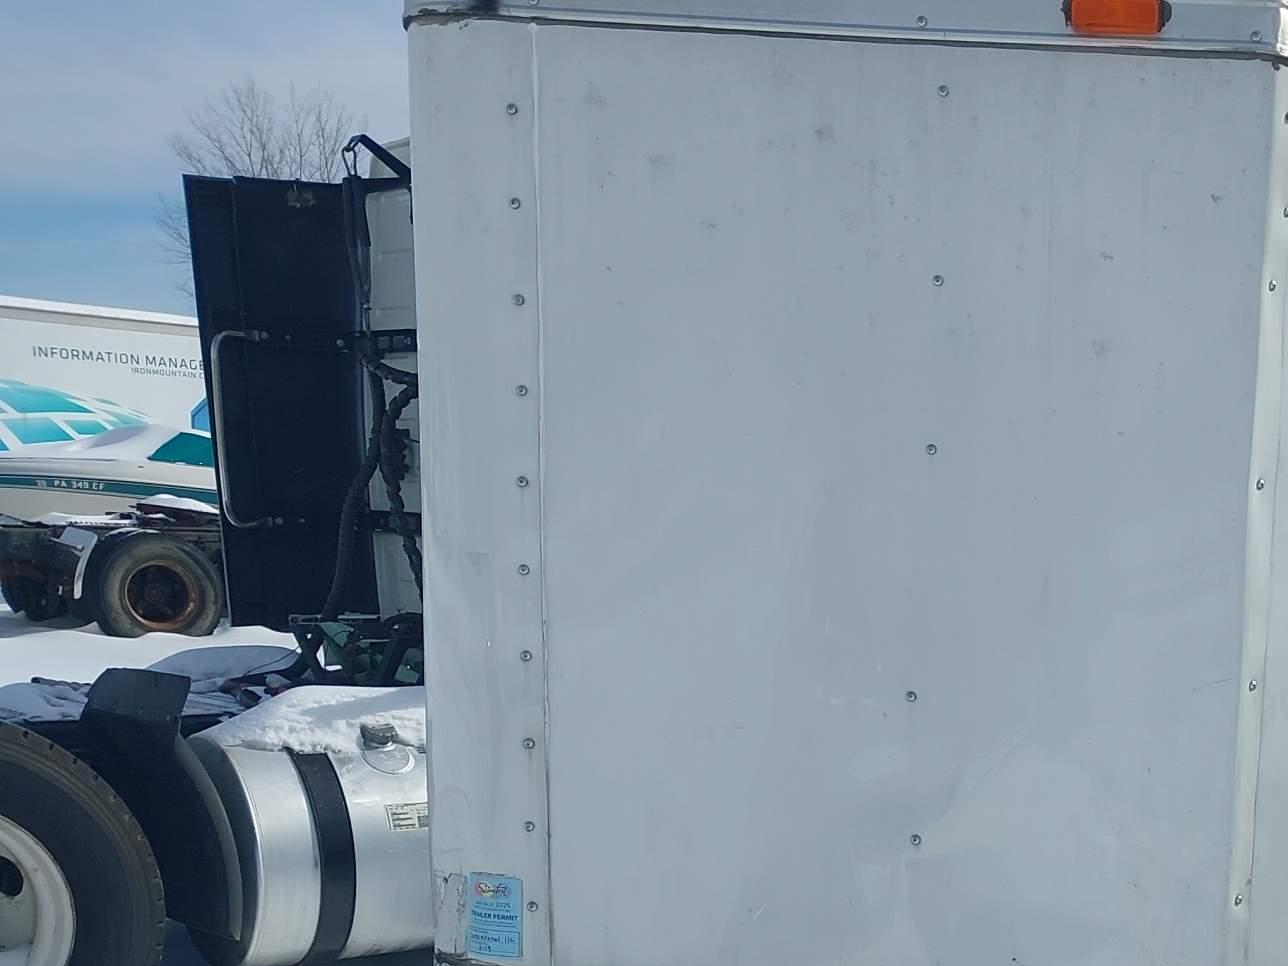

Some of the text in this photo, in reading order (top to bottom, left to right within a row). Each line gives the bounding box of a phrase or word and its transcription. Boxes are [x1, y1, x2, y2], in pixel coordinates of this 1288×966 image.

[32, 345, 140, 366] INFORMATION
[54, 480, 67, 488] PA
[92, 482, 105, 490] CF
[471, 909, 518, 921] TRAILER PERMIT
